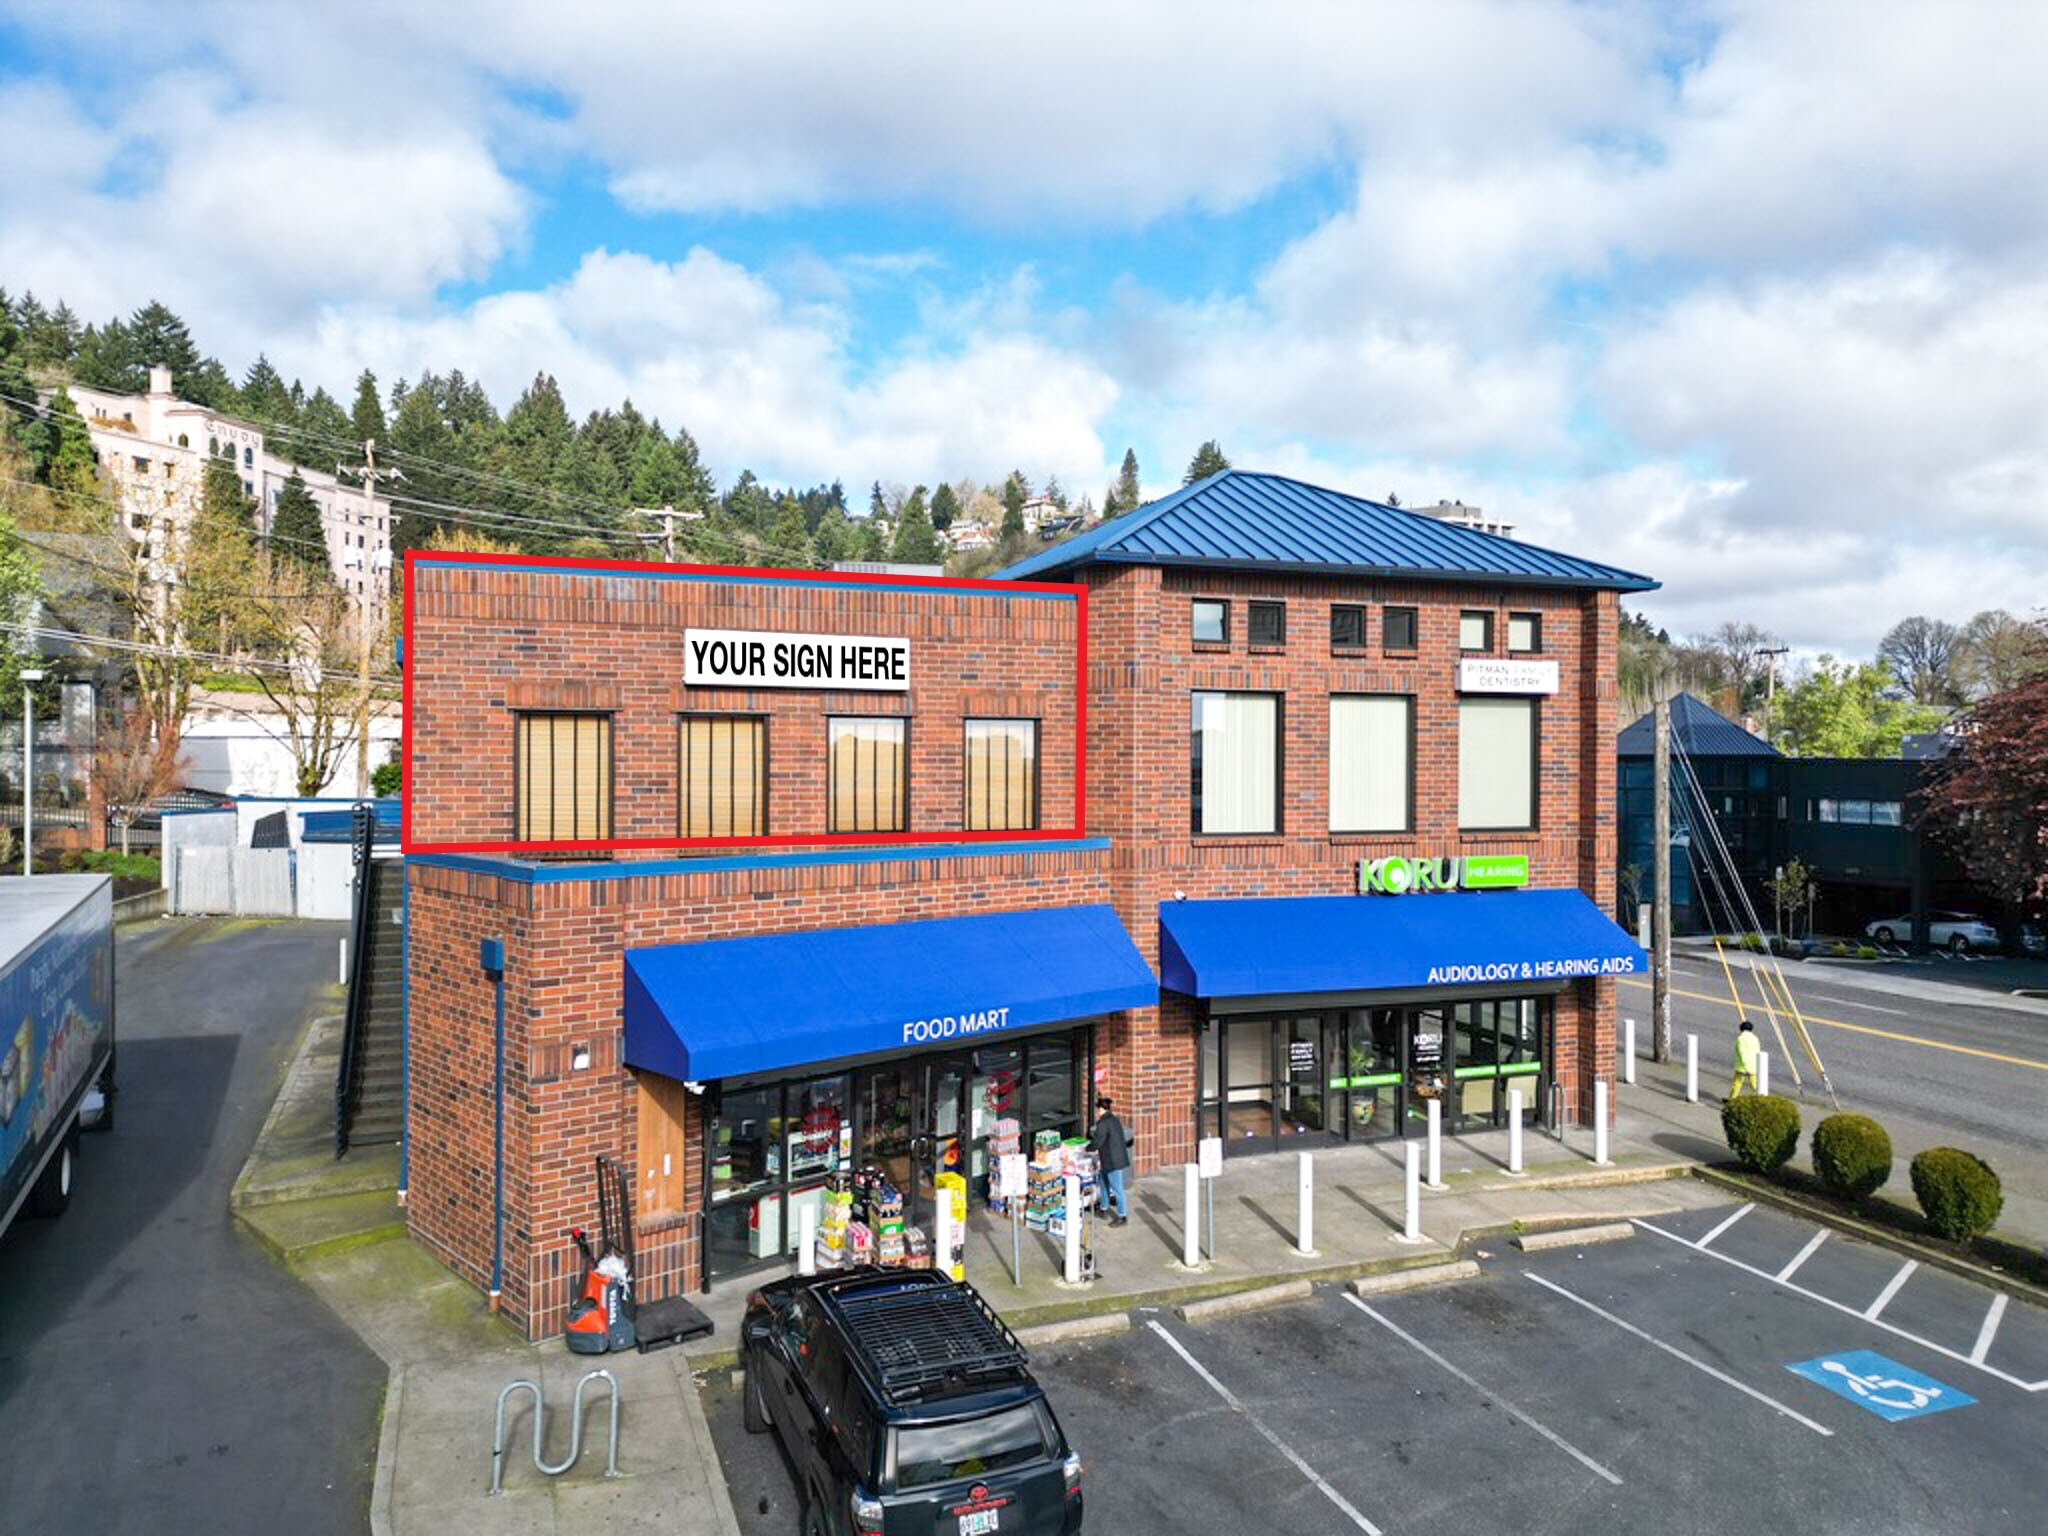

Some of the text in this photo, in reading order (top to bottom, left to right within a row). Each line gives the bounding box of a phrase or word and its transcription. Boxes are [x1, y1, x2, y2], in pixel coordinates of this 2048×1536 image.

[691, 640, 906, 680] YOUR SIGN HERE
[1467, 663, 1509, 674] PITMAN
[1479, 676, 1541, 687] DENTISTRY
[1359, 855, 1525, 894] KORU HEARING
[1427, 956, 1634, 984] AUDIOLOGY & HEARING AIDS
[903, 1007, 1010, 1043] FOOD MART
